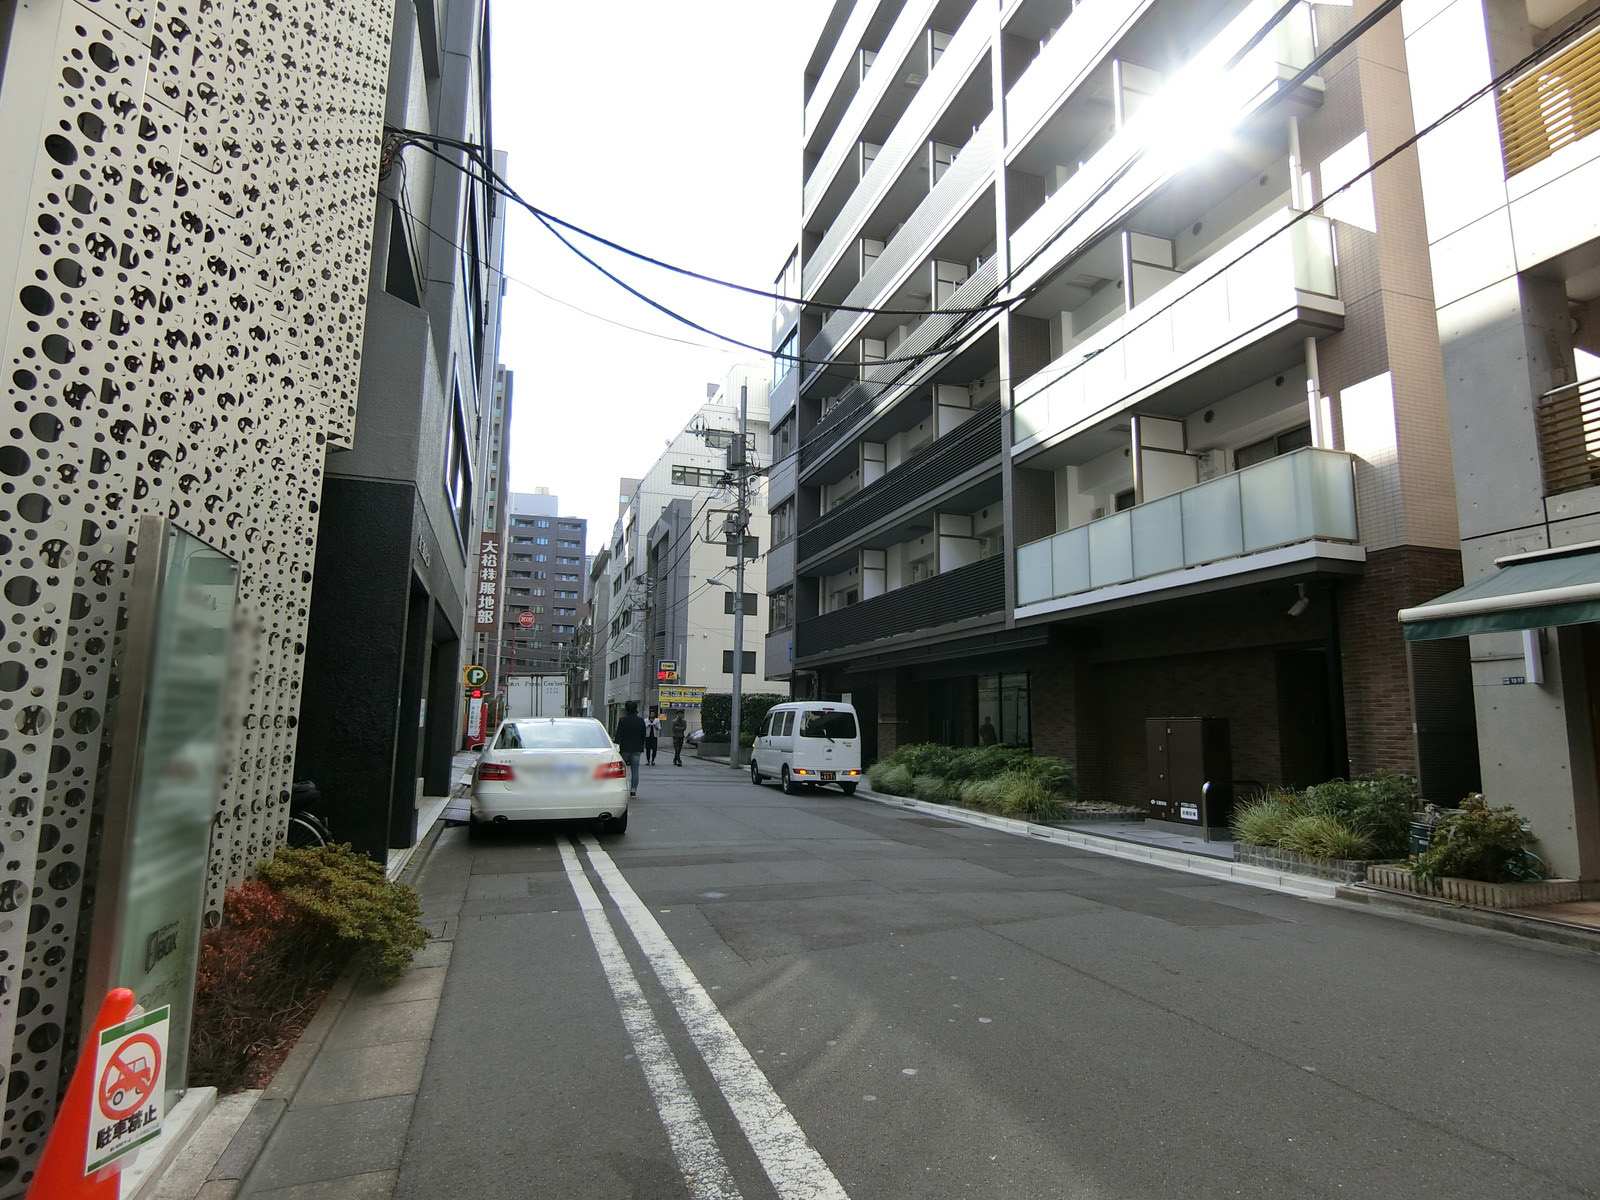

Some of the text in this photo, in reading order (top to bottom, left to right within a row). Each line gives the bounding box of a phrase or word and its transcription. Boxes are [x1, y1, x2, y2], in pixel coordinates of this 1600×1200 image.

[472, 670, 484, 684] P
[95, 1104, 157, 1151] 駐車禁止
